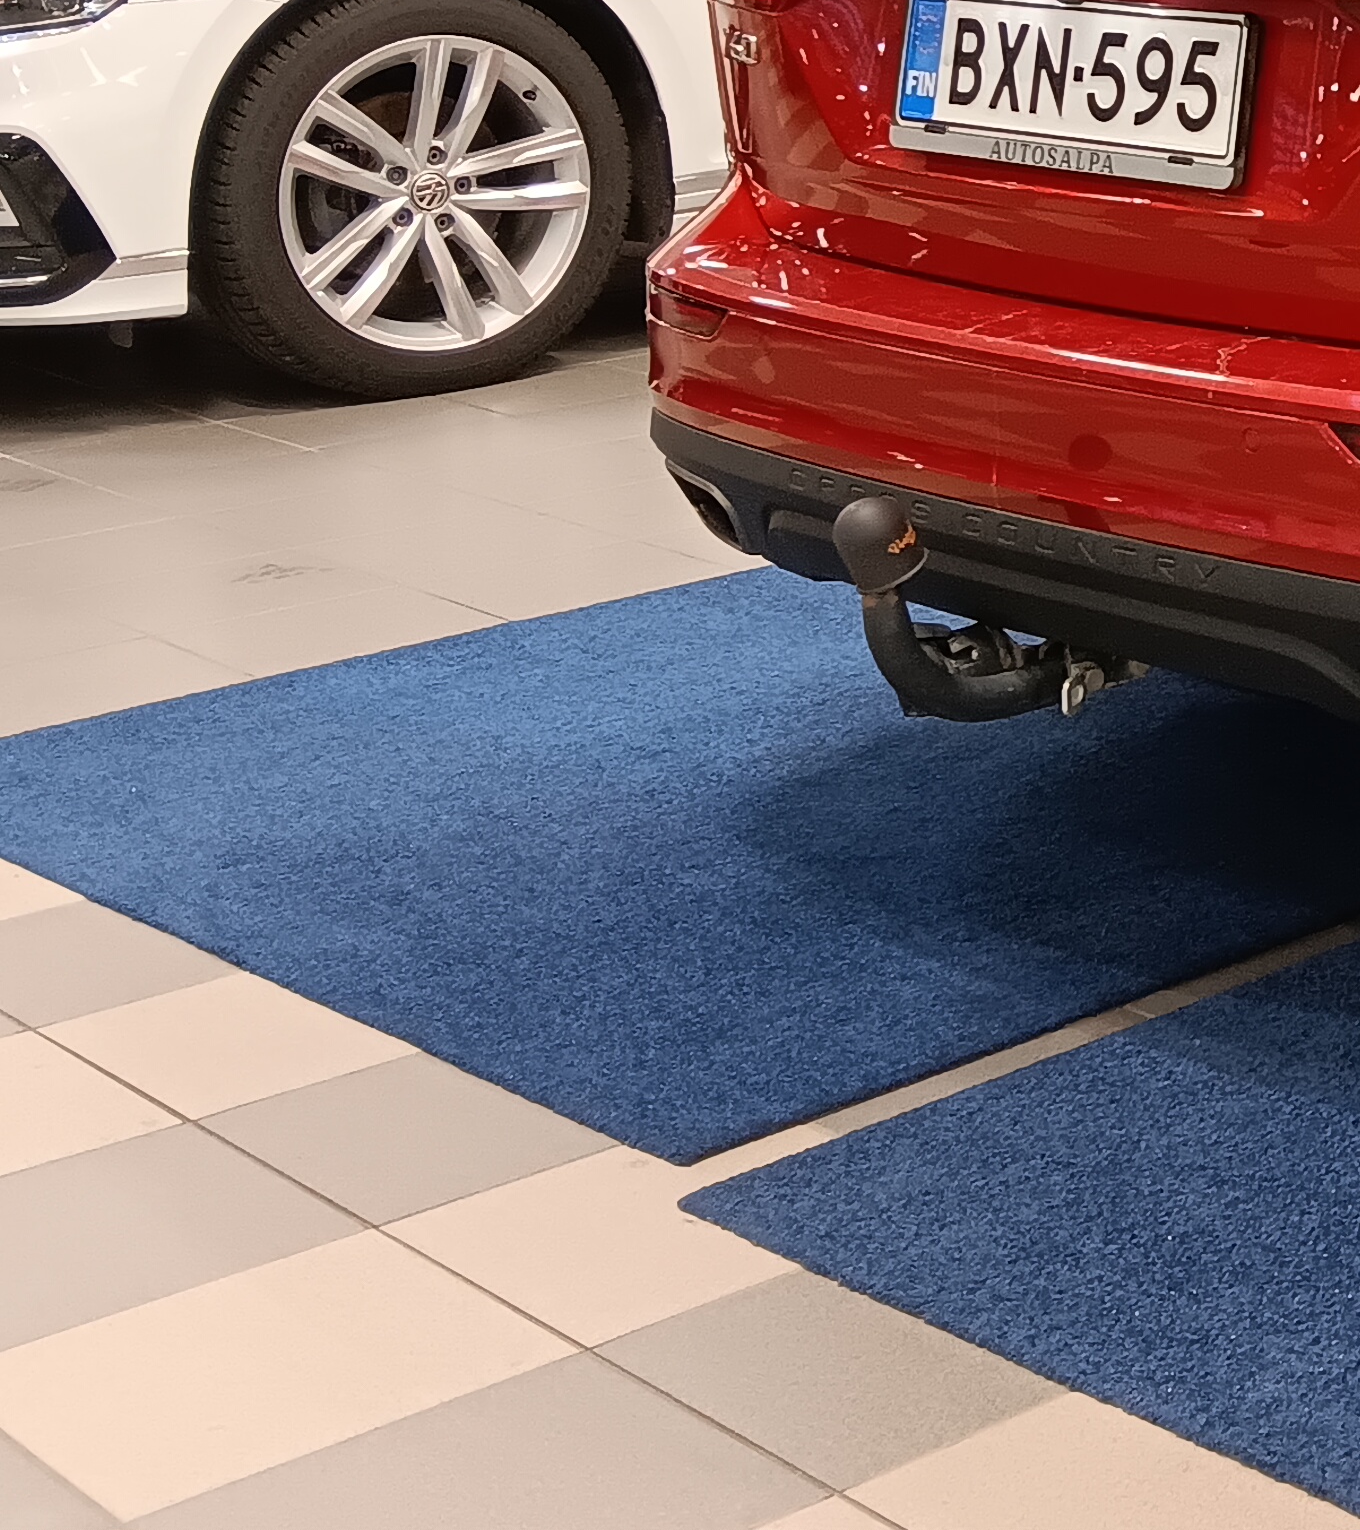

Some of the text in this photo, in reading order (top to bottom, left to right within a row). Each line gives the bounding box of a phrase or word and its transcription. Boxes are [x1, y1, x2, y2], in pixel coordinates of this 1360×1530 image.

[905, 69, 937, 98] FIN
[948, 17, 1220, 133] BXN-595
[988, 139, 1115, 175] AUTOSALPA
[789, 467, 1223, 589] CROS COUNTRY
